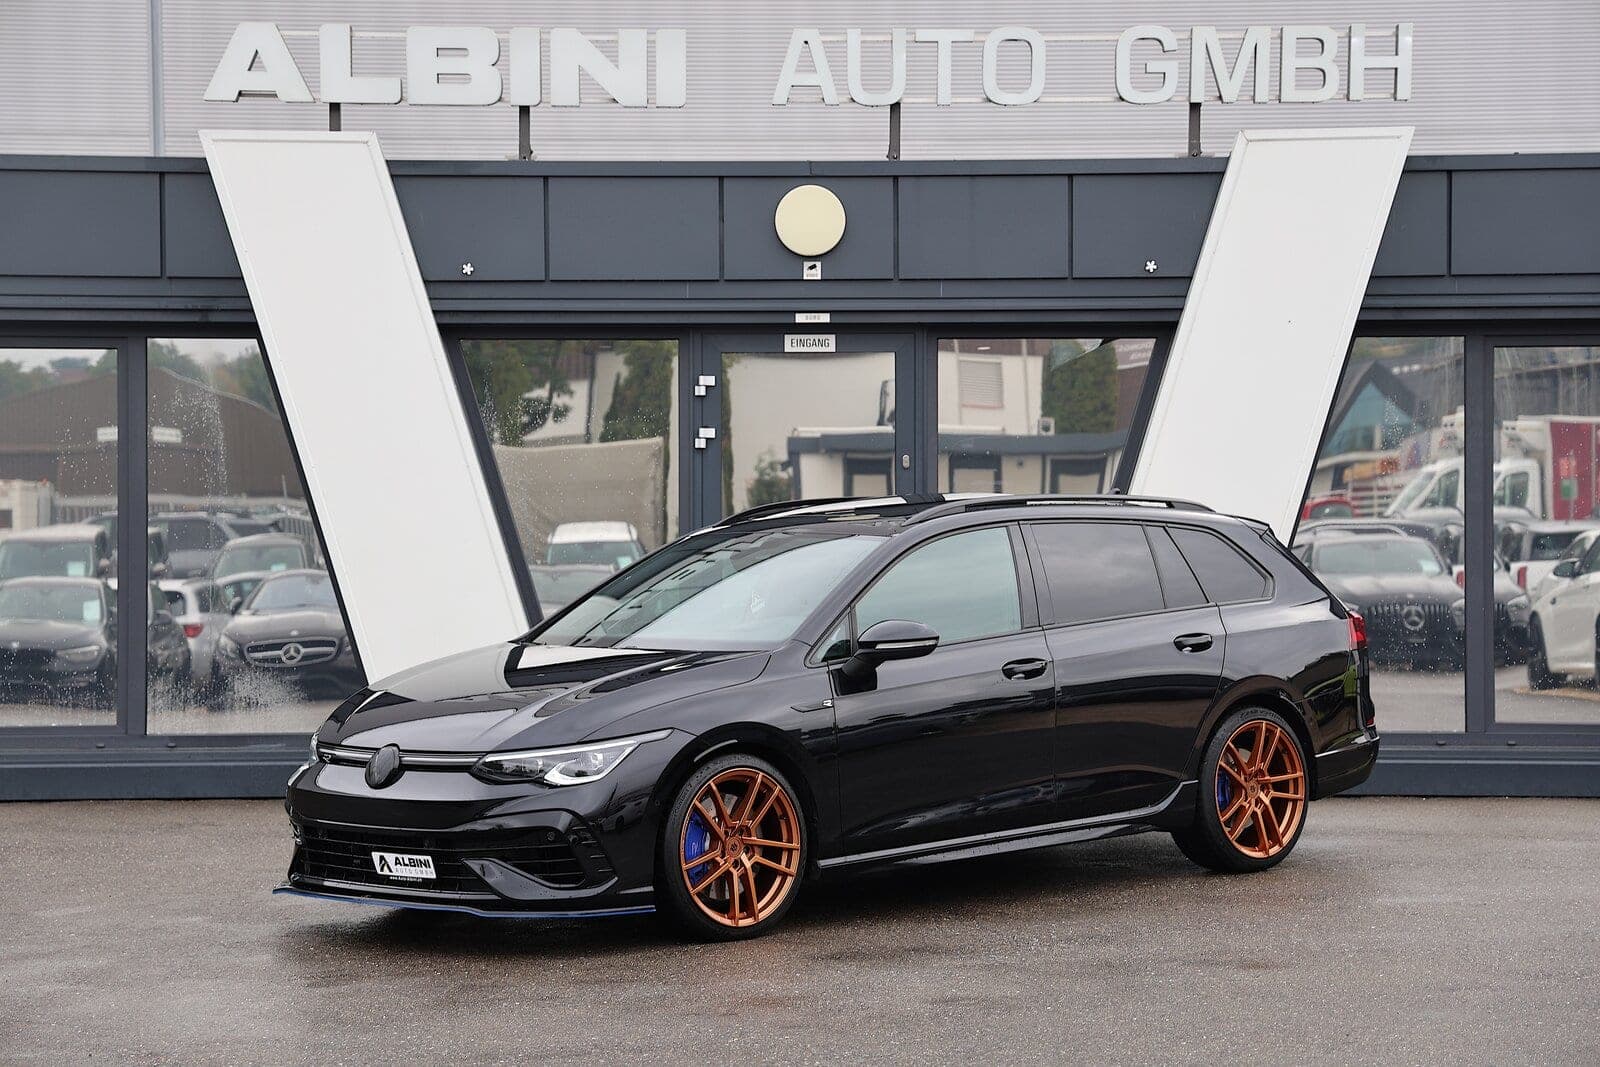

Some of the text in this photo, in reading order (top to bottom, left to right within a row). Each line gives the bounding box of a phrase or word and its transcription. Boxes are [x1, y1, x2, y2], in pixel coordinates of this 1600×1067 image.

[203, 22, 1414, 108] ALBINI AUTO GMBH
[790, 338, 830, 348] EINGANG
[394, 856, 432, 869] ALBINI
